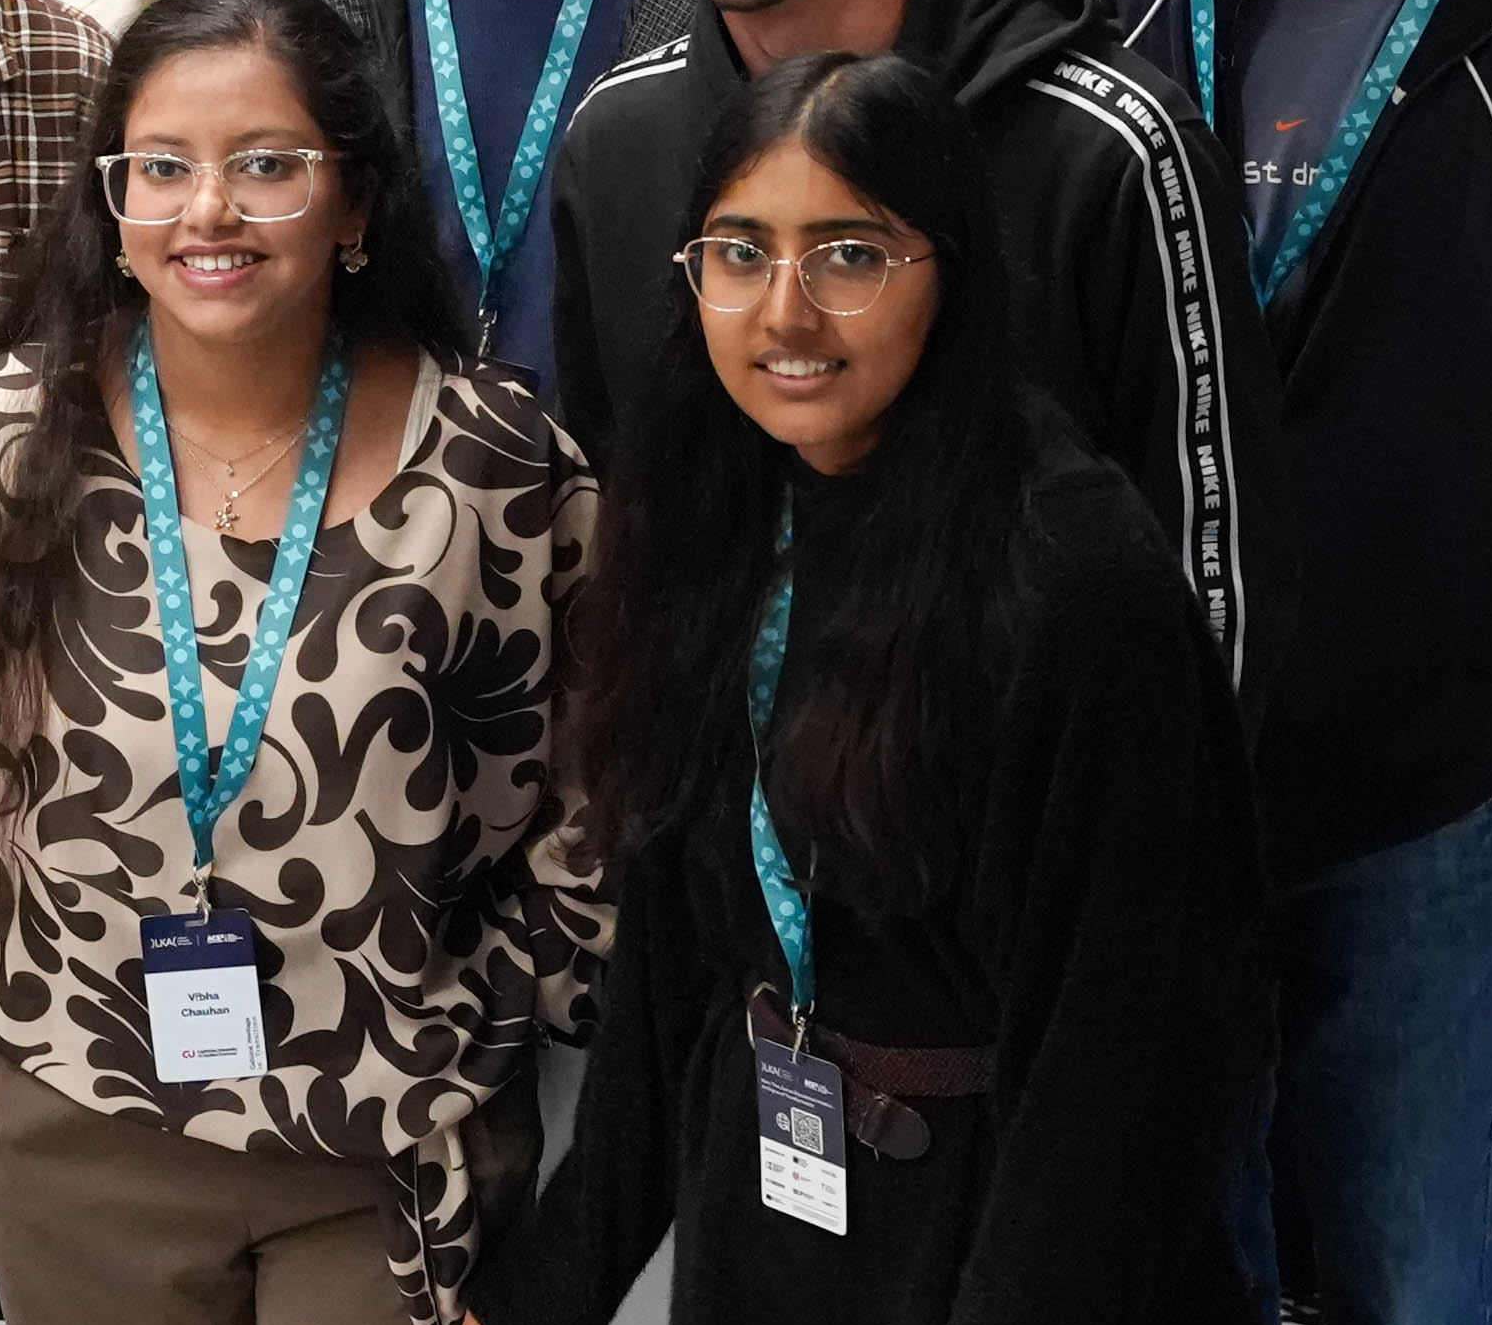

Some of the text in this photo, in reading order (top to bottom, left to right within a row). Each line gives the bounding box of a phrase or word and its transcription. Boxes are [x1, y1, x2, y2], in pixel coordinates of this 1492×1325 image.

[1054, 62, 1114, 98] NIKE
[1115, 93, 1166, 150] NIKE
[1158, 156, 1186, 221] NIKE
[1175, 229, 1197, 294] NIKE
[1185, 301, 1209, 366] NIKE
[1195, 374, 1212, 434] NIKE
[1197, 444, 1220, 510] NIKE
[1201, 519, 1221, 578] NIKE
[181, 1007, 230, 1017] Chauhan
